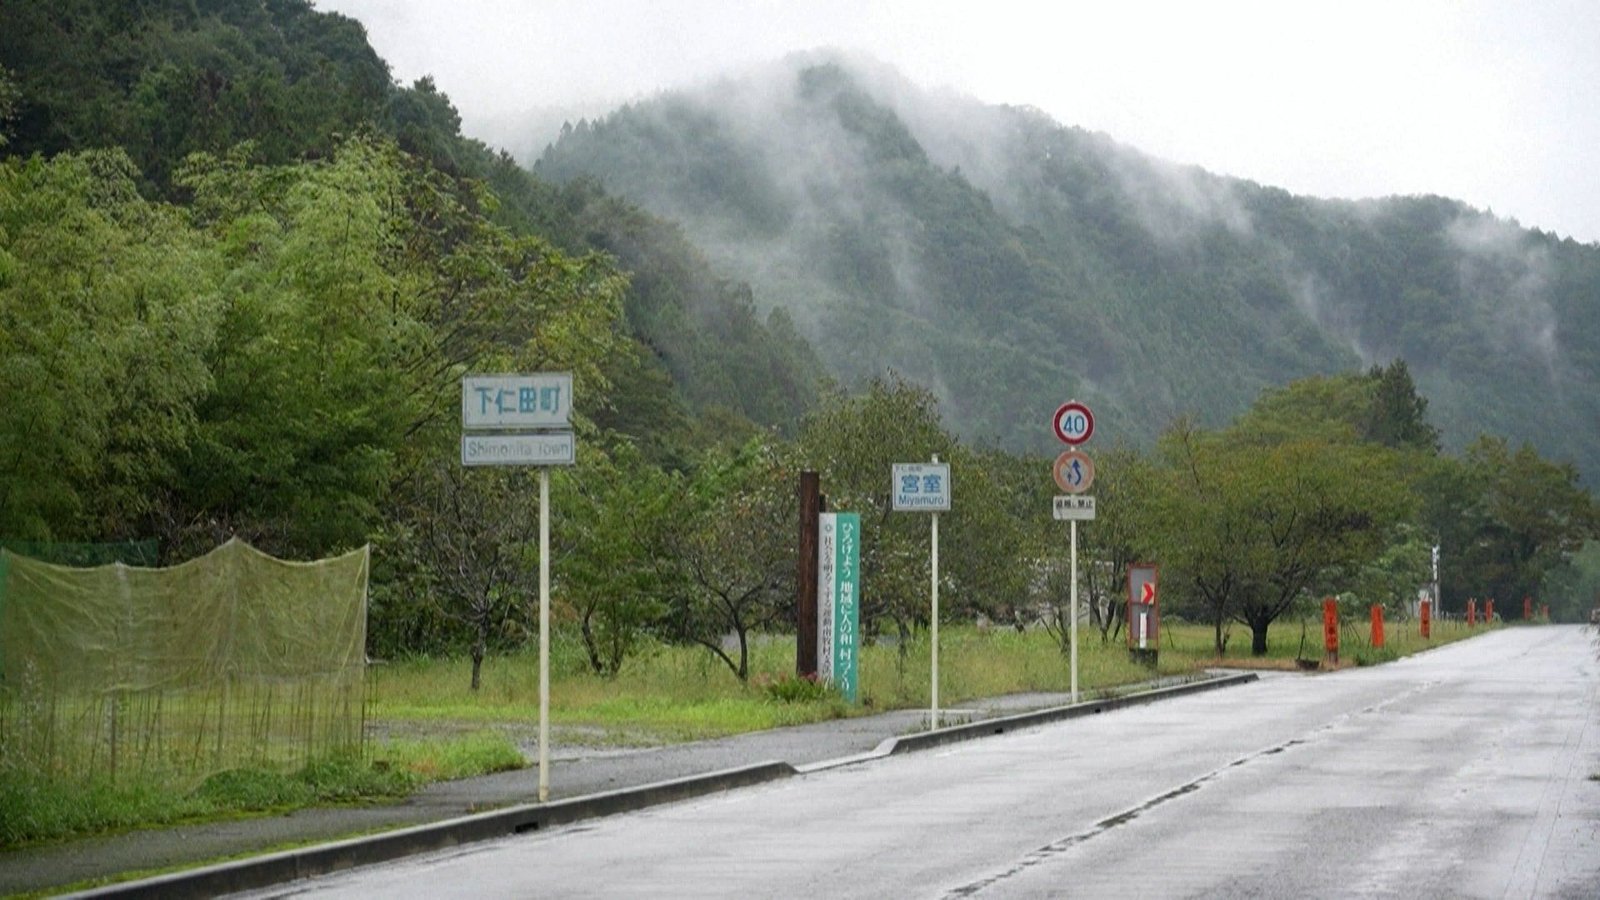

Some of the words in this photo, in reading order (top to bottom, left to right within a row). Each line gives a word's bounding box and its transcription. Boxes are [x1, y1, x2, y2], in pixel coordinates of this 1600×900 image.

[475, 385, 561, 415] 下仁田町
[1063, 414, 1085, 434] 40
[468, 441, 532, 457] Shimonita
[538, 443, 569, 456] Town
[901, 474, 942, 493] 宮室
[899, 494, 944, 507] Miyamuro
